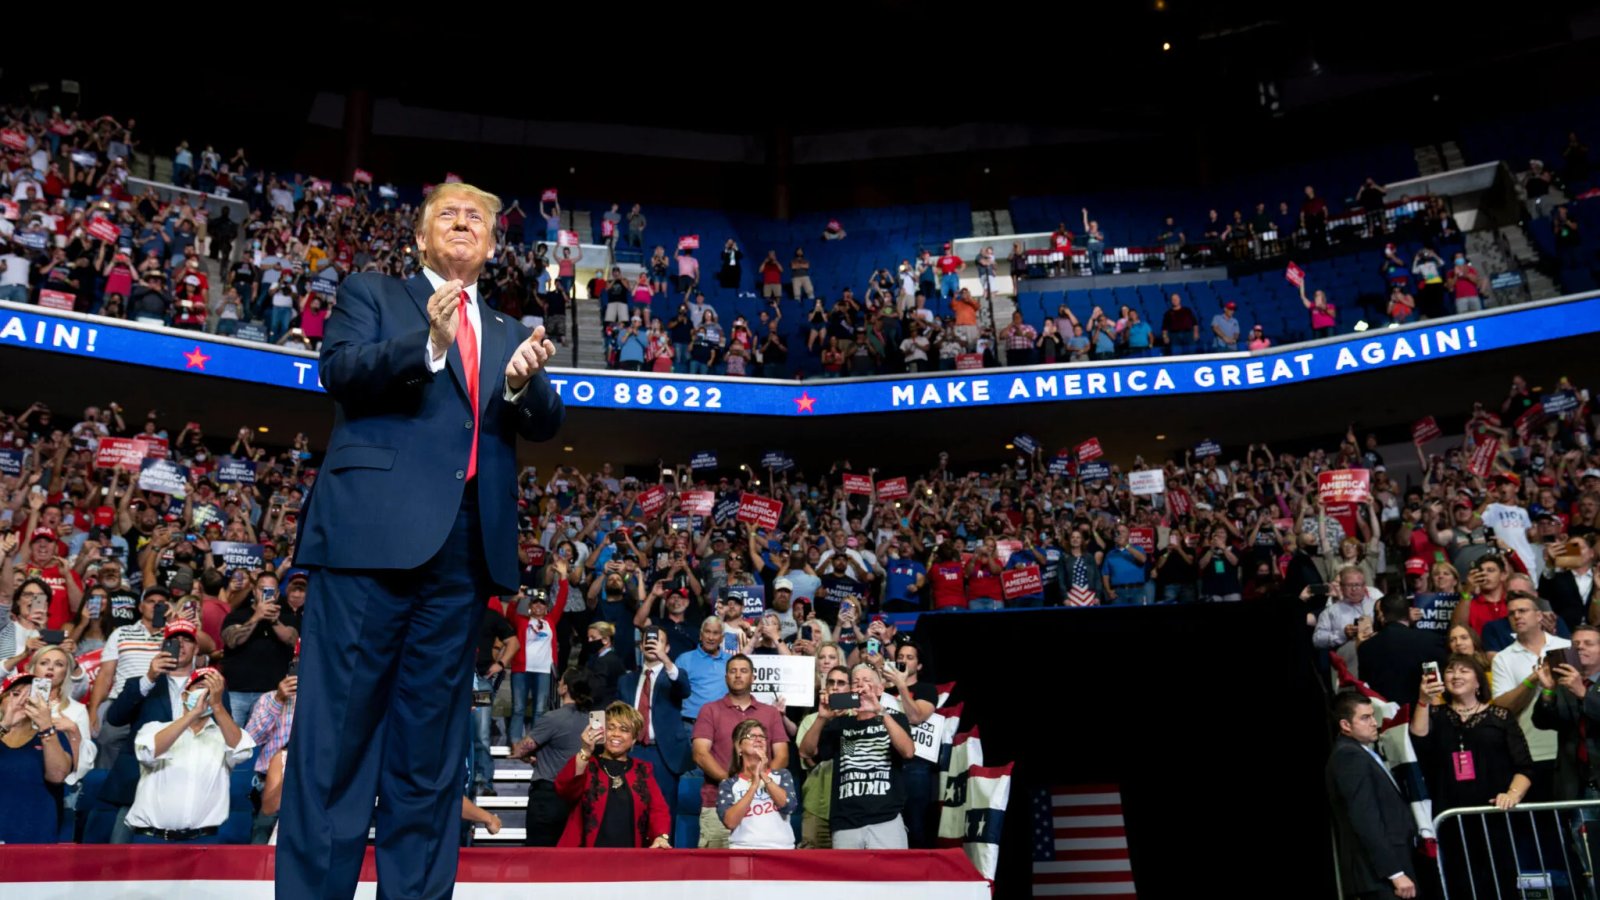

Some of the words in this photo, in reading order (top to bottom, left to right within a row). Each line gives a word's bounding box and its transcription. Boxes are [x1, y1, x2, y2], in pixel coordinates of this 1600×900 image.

[0, 316, 98, 352] AIN!
[893, 379, 990, 407] MAKE
[1009, 369, 1176, 399] AMERICA
[1194, 353, 1314, 388] GREAT
[1336, 326, 1477, 375] AGAIN!
[551, 380, 595, 402] TO
[614, 383, 722, 409] 88022
[100, 448, 144, 458] AMERICA
[141, 468, 187, 483] AMERICA
[219, 467, 254, 476] AMERICA
[1320, 480, 1366, 491] AMERICA
[753, 499, 770, 507] MAKE
[741, 503, 777, 517] AMERICA
[739, 511, 758, 519] GREAT
[758, 515, 777, 524] AGAIN
[227, 547, 249, 555] MAKE
[223, 555, 262, 565] MERICA
[1012, 570, 1028, 579] MAKE
[1005, 574, 1039, 588] AMERICA
[112, 608, 134, 620] 020
[1416, 620, 1449, 630] GREAT
[752, 667, 781, 681] COPS
[751, 684, 770, 692] FOR
[911, 730, 934, 748] COP
[868, 770, 890, 780] WITH
[839, 780, 891, 799] TRUMP
